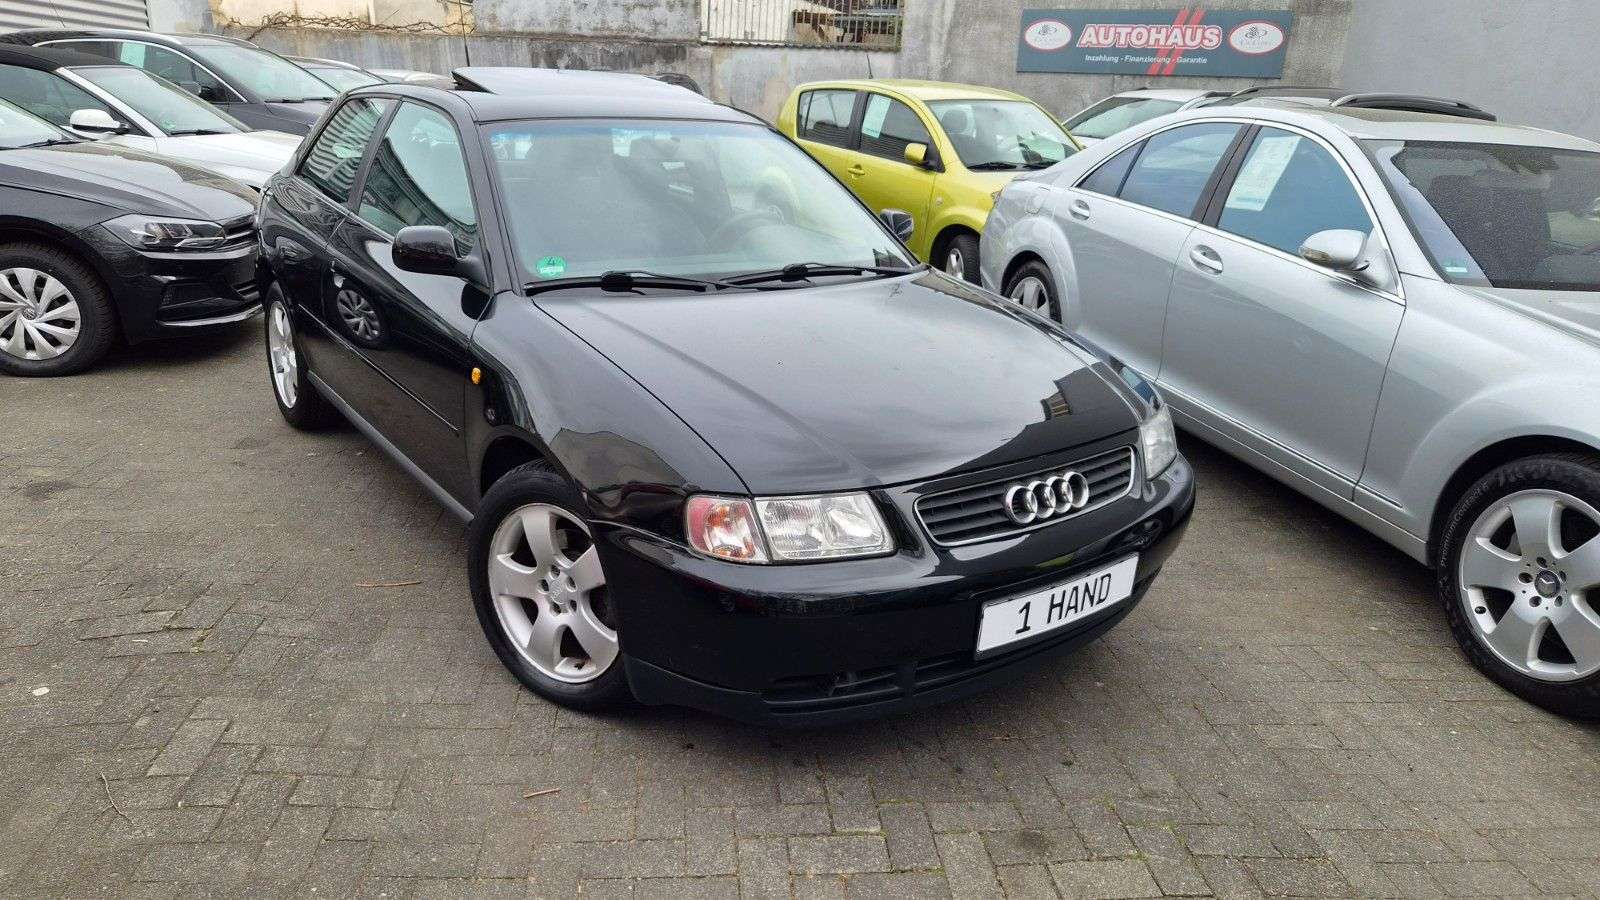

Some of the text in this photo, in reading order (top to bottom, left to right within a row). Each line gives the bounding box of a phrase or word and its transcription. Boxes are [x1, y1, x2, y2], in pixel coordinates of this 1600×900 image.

[1077, 24, 1222, 49] AUTOHAUS
[1085, 54, 1119, 64] Inzahlung
[1124, 54, 1171, 64] Finanzierung
[1176, 55, 1208, 64] Garantie
[546, 256, 556, 266] 4
[1015, 572, 1112, 635] 1 HAND
